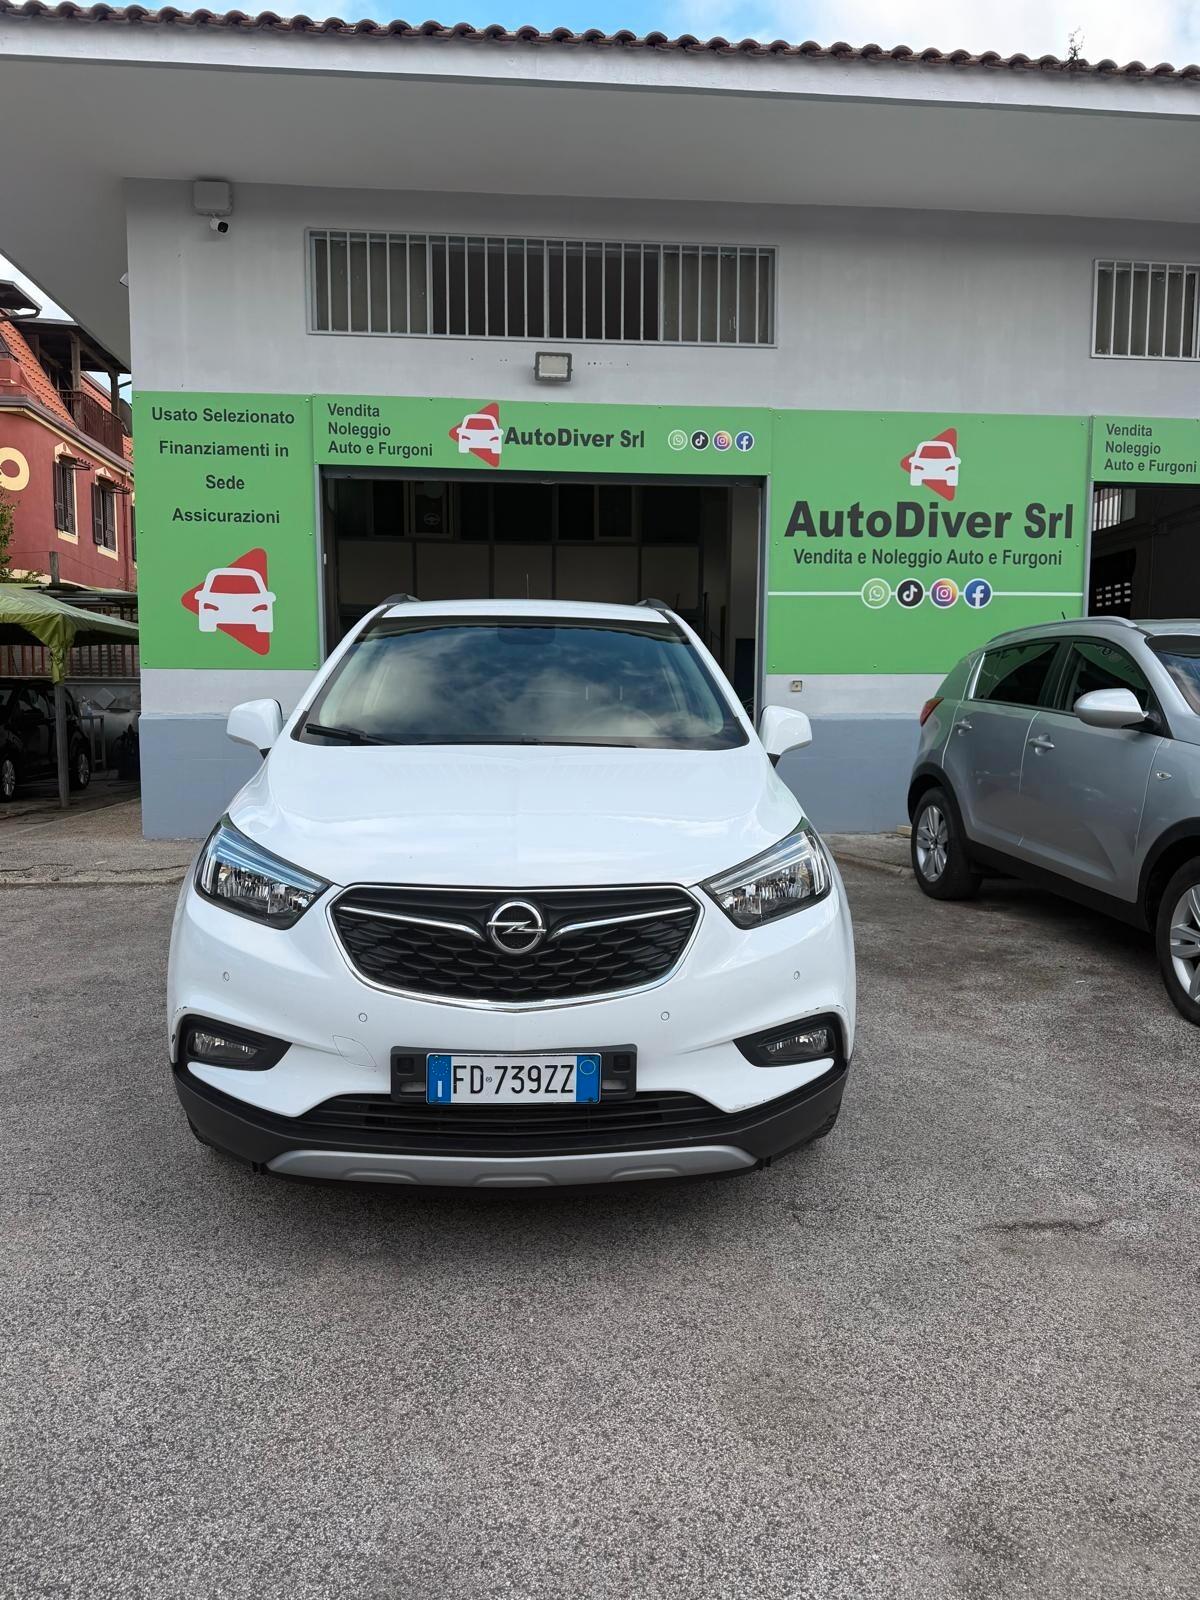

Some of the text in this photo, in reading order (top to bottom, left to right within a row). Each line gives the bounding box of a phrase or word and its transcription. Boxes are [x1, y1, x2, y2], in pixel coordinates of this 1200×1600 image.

[152, 407, 294, 424] Usato Selezionato
[328, 403, 379, 417] Vendita
[329, 423, 390, 438] Noleggio
[504, 427, 644, 448] AutoDiver Srl
[1106, 424, 1152, 436] Vendita
[160, 441, 288, 457] Finanziamenti in
[328, 441, 432, 459] Auto e Furgoni
[1106, 441, 1161, 457] Noleggio
[1104, 458, 1198, 475] Auto e Furgoni
[206, 475, 244, 489] Sede
[173, 508, 279, 523] Assicurazioni
[784, 501, 1073, 538] AutoDiver Srl
[794, 549, 1062, 568] Vendita e Noleggio Auto e Furgoni
